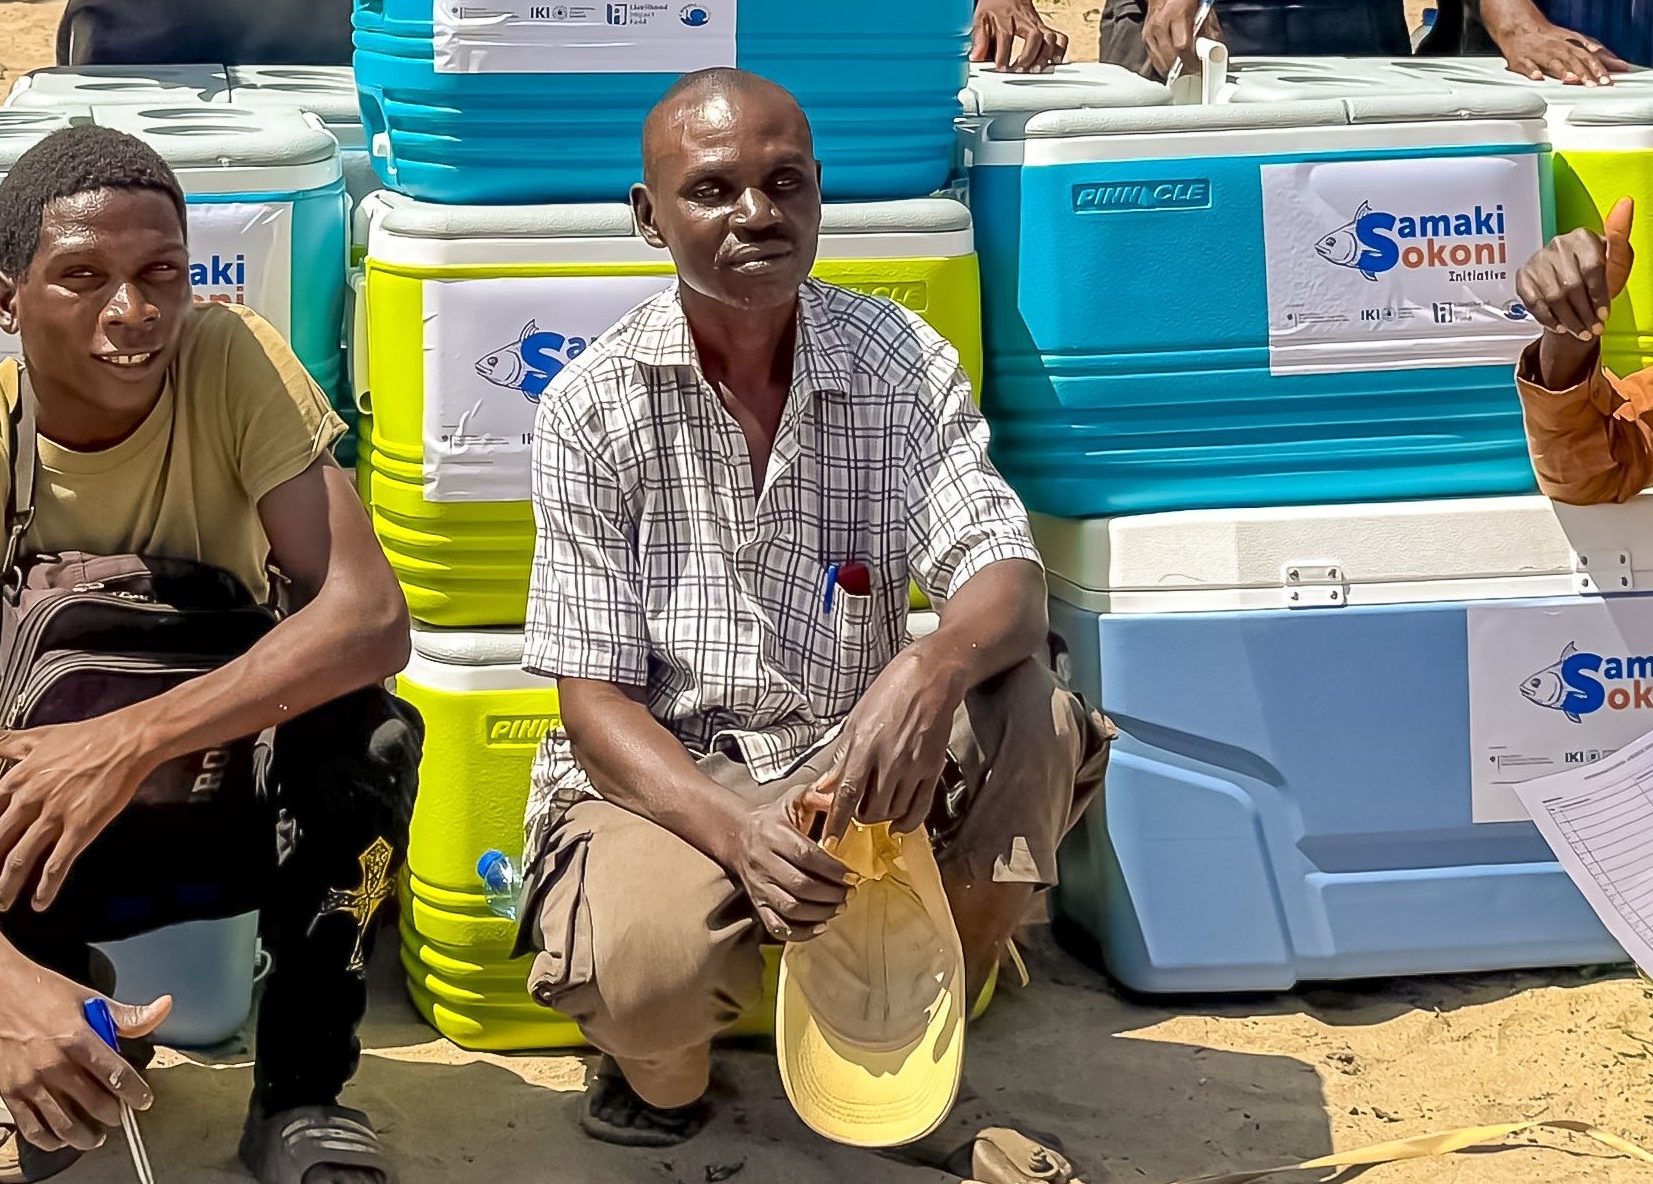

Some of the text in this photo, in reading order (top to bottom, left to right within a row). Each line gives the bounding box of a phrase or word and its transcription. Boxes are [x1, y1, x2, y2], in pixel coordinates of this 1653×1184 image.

[531, 7, 550, 19] IKI
[190, 255, 245, 285] aki
[1449, 270, 1507, 282] Initiative
[1361, 309, 1380, 320] IKI
